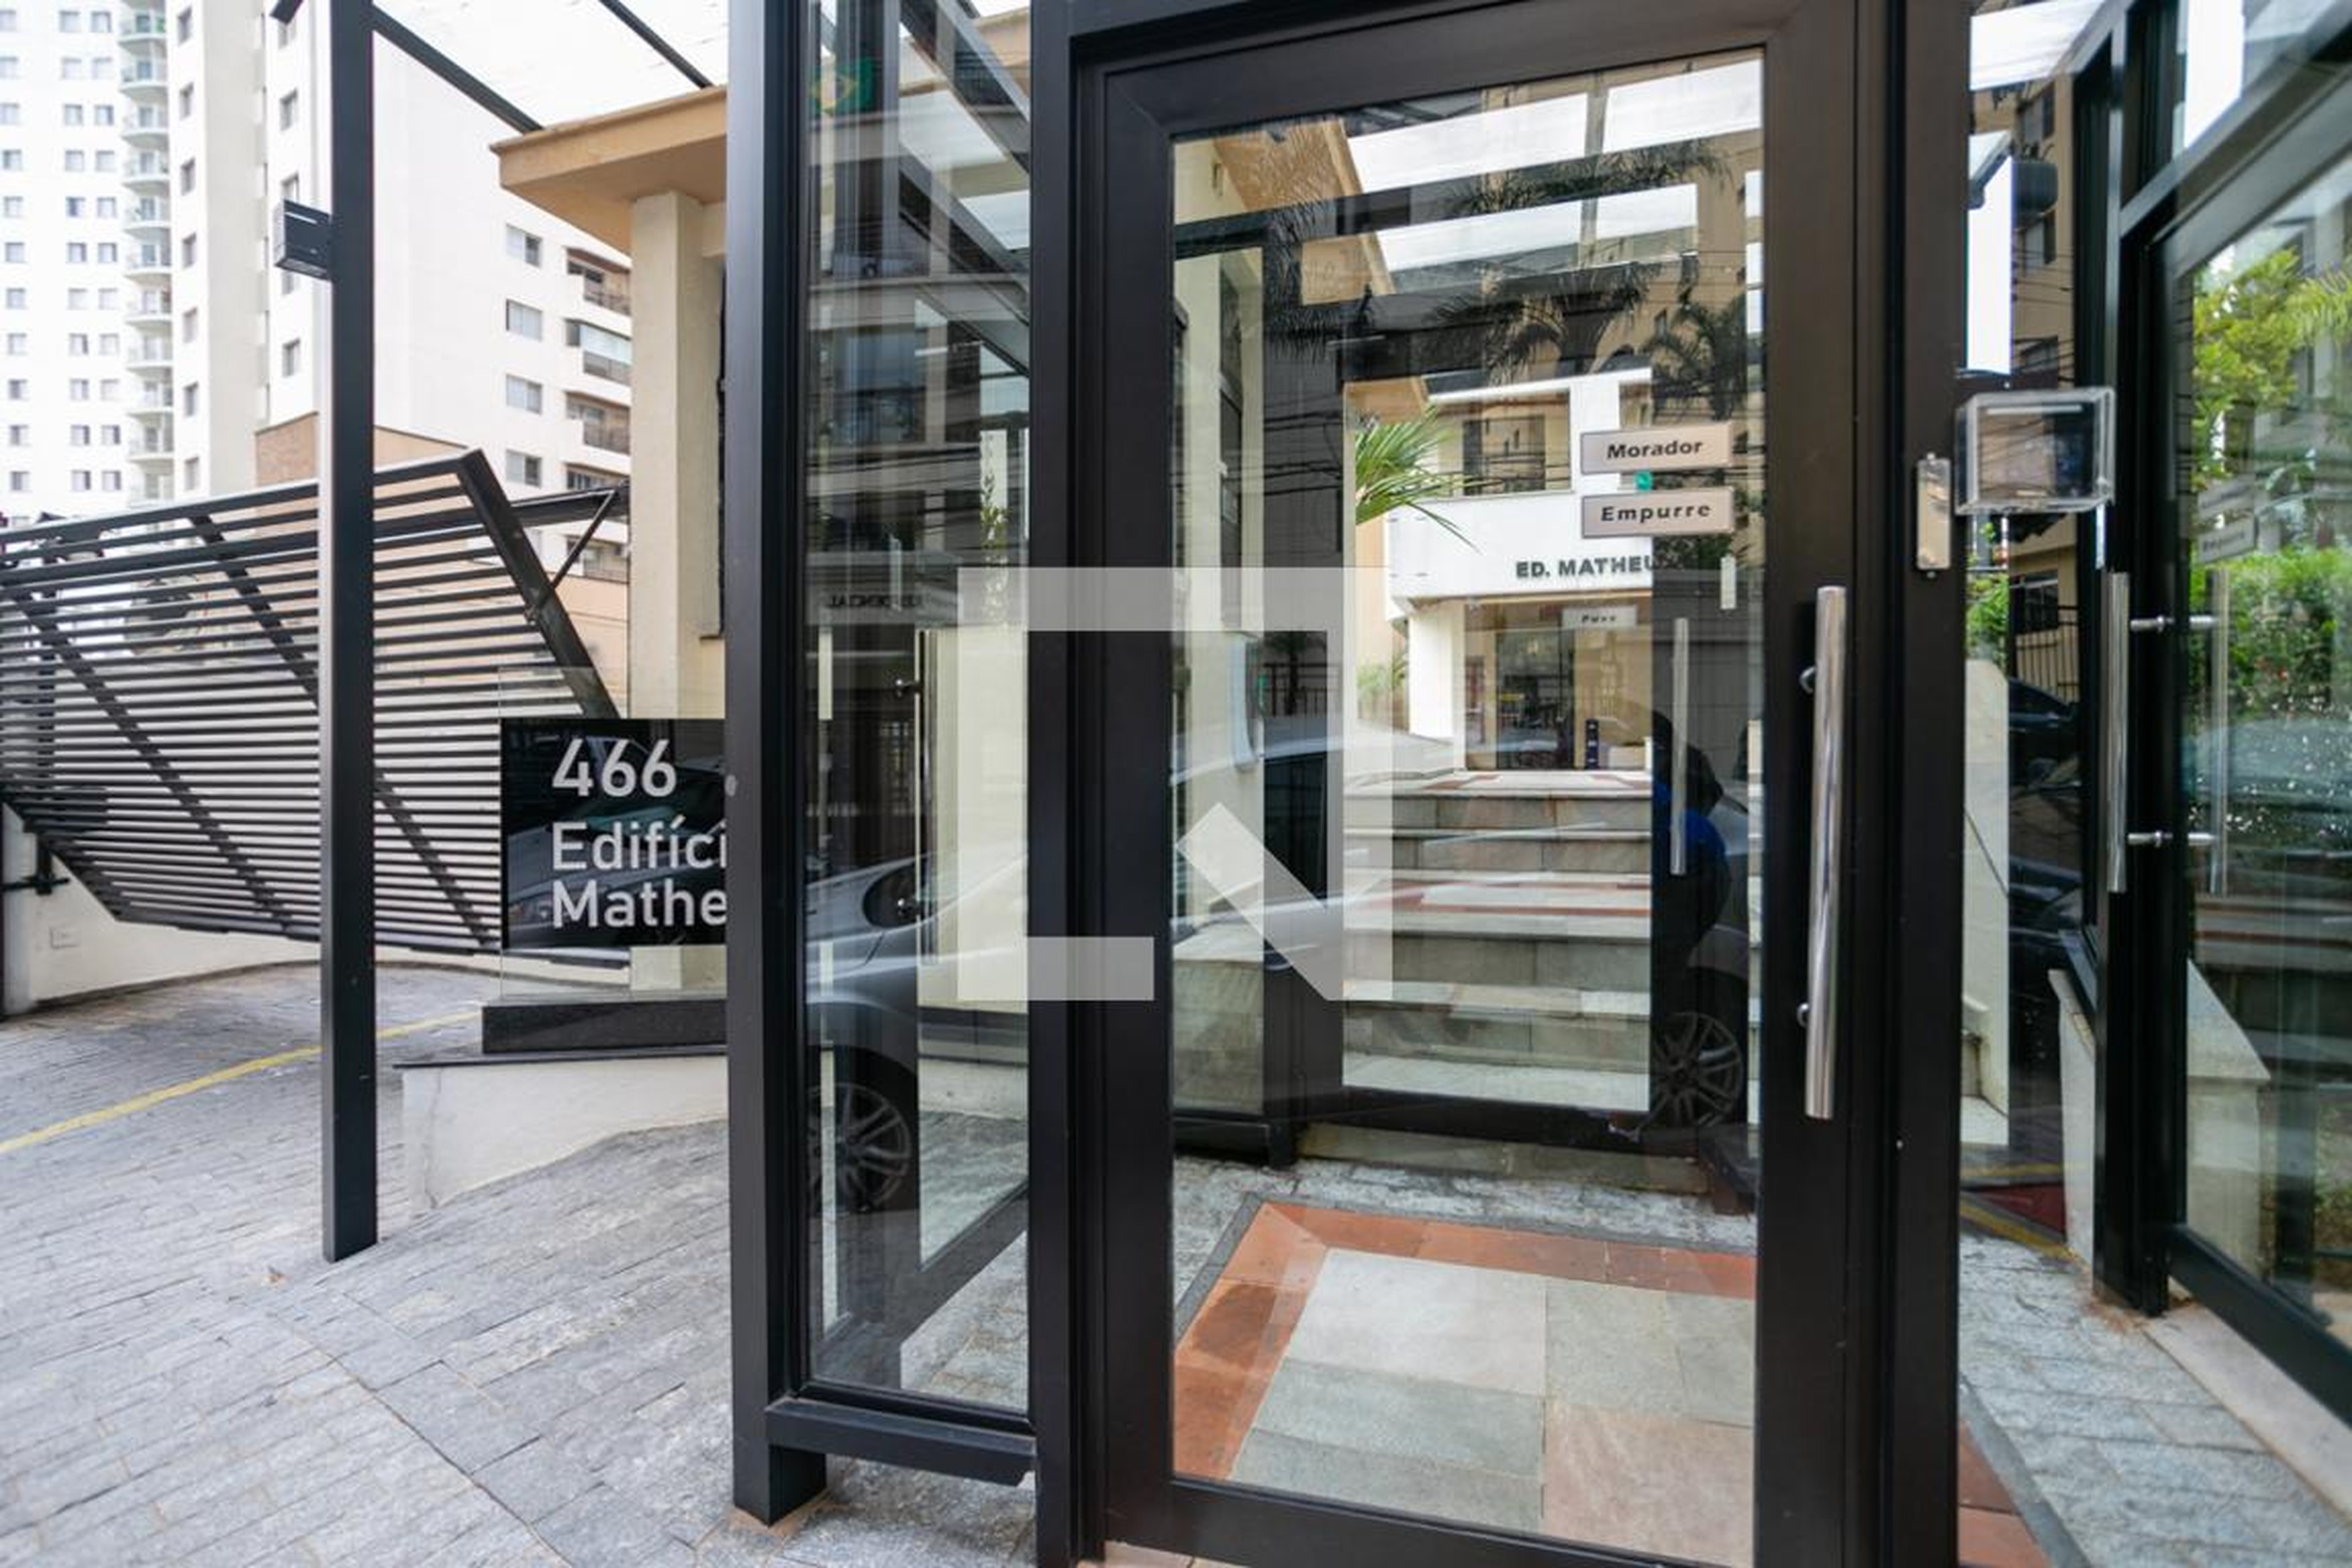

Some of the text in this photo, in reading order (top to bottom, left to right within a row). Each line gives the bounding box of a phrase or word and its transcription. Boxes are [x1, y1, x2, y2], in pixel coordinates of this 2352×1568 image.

[1607, 440, 1703, 459] Morador
[1600, 503, 1712, 523] Empurre
[1515, 560, 1550, 578] ED.
[552, 739, 677, 797] 466
[552, 878, 727, 928] Mathe
